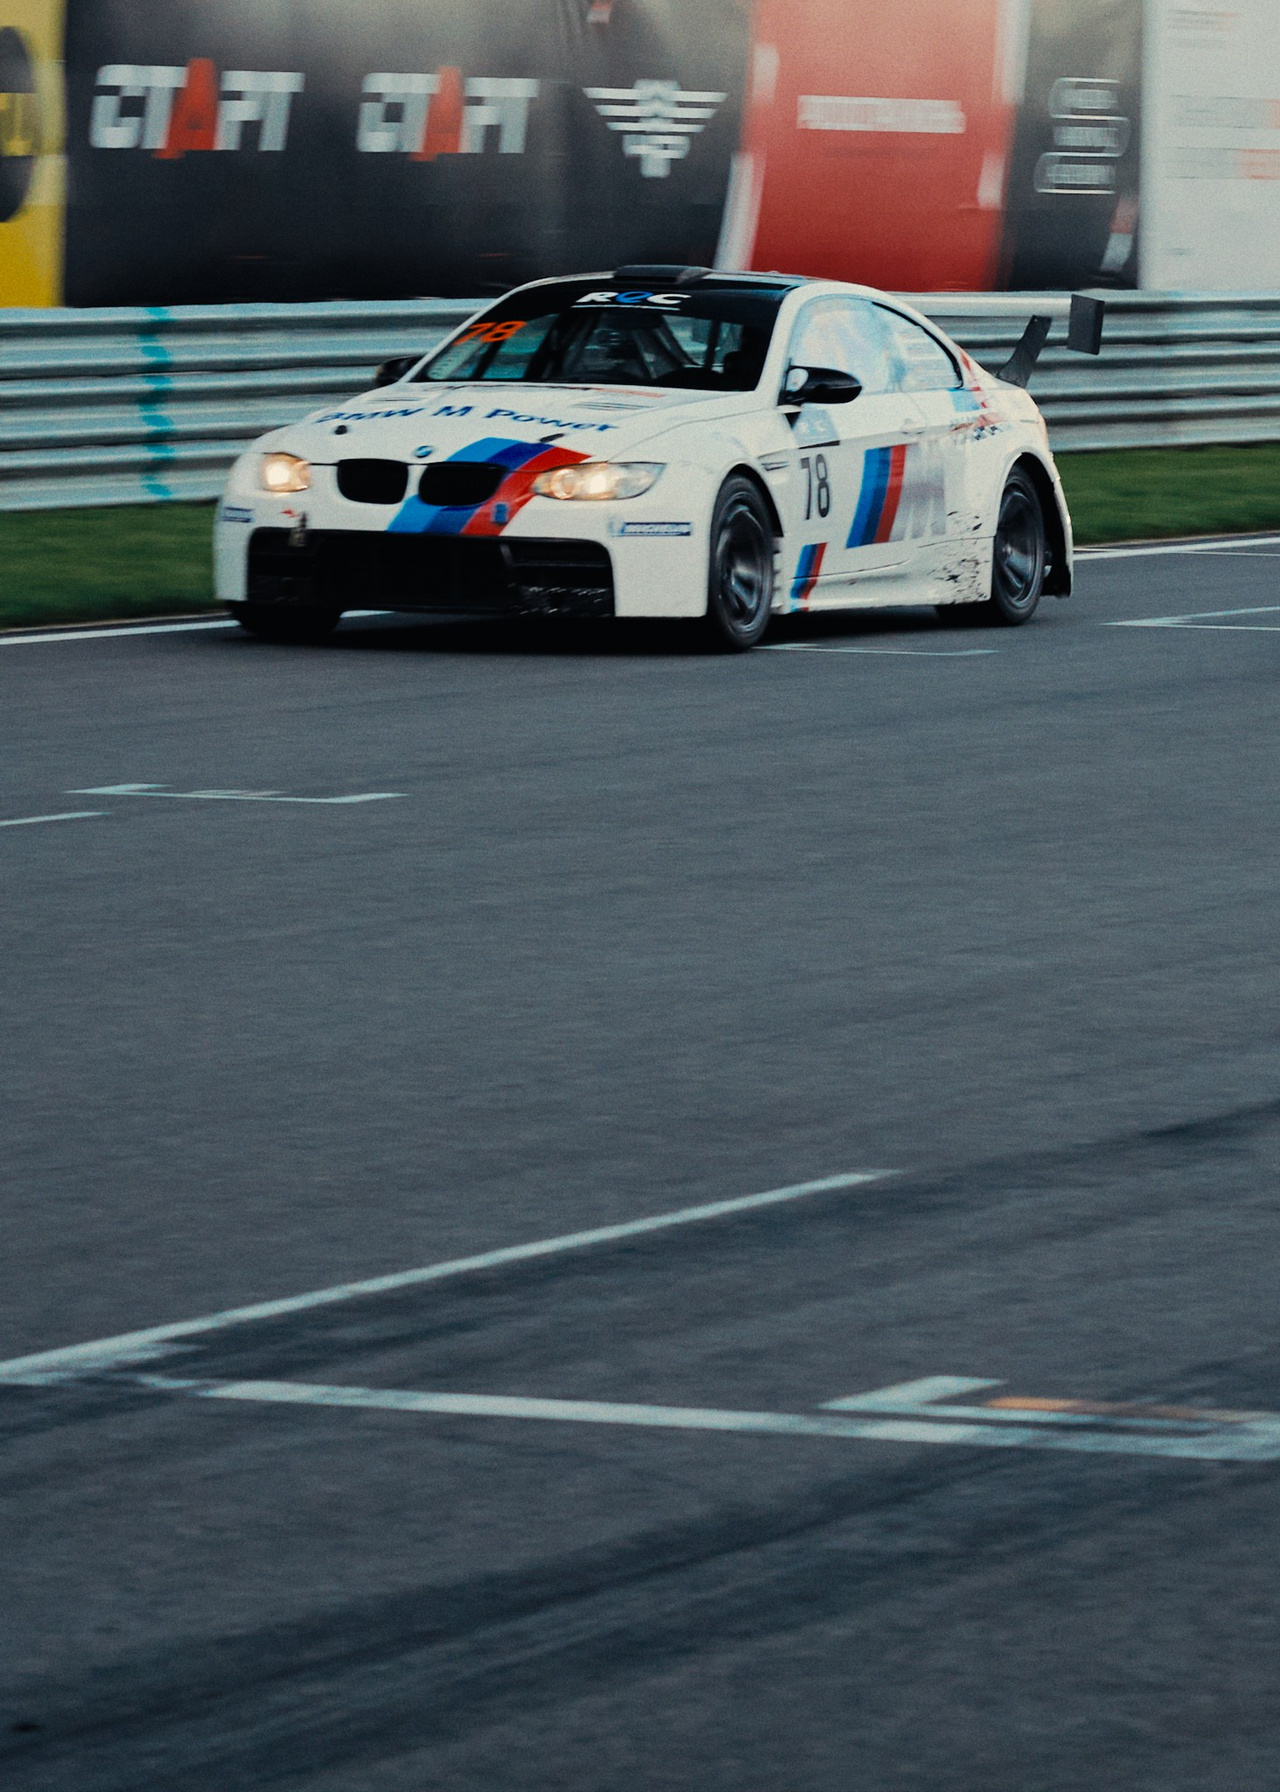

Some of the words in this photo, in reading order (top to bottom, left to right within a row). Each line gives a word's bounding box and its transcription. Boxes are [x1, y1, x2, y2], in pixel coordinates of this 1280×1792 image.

[453, 321, 527, 345] 78
[314, 407, 425, 424] BMW
[432, 405, 472, 418] M
[484, 408, 620, 432] Power
[799, 453, 830, 520] 78
